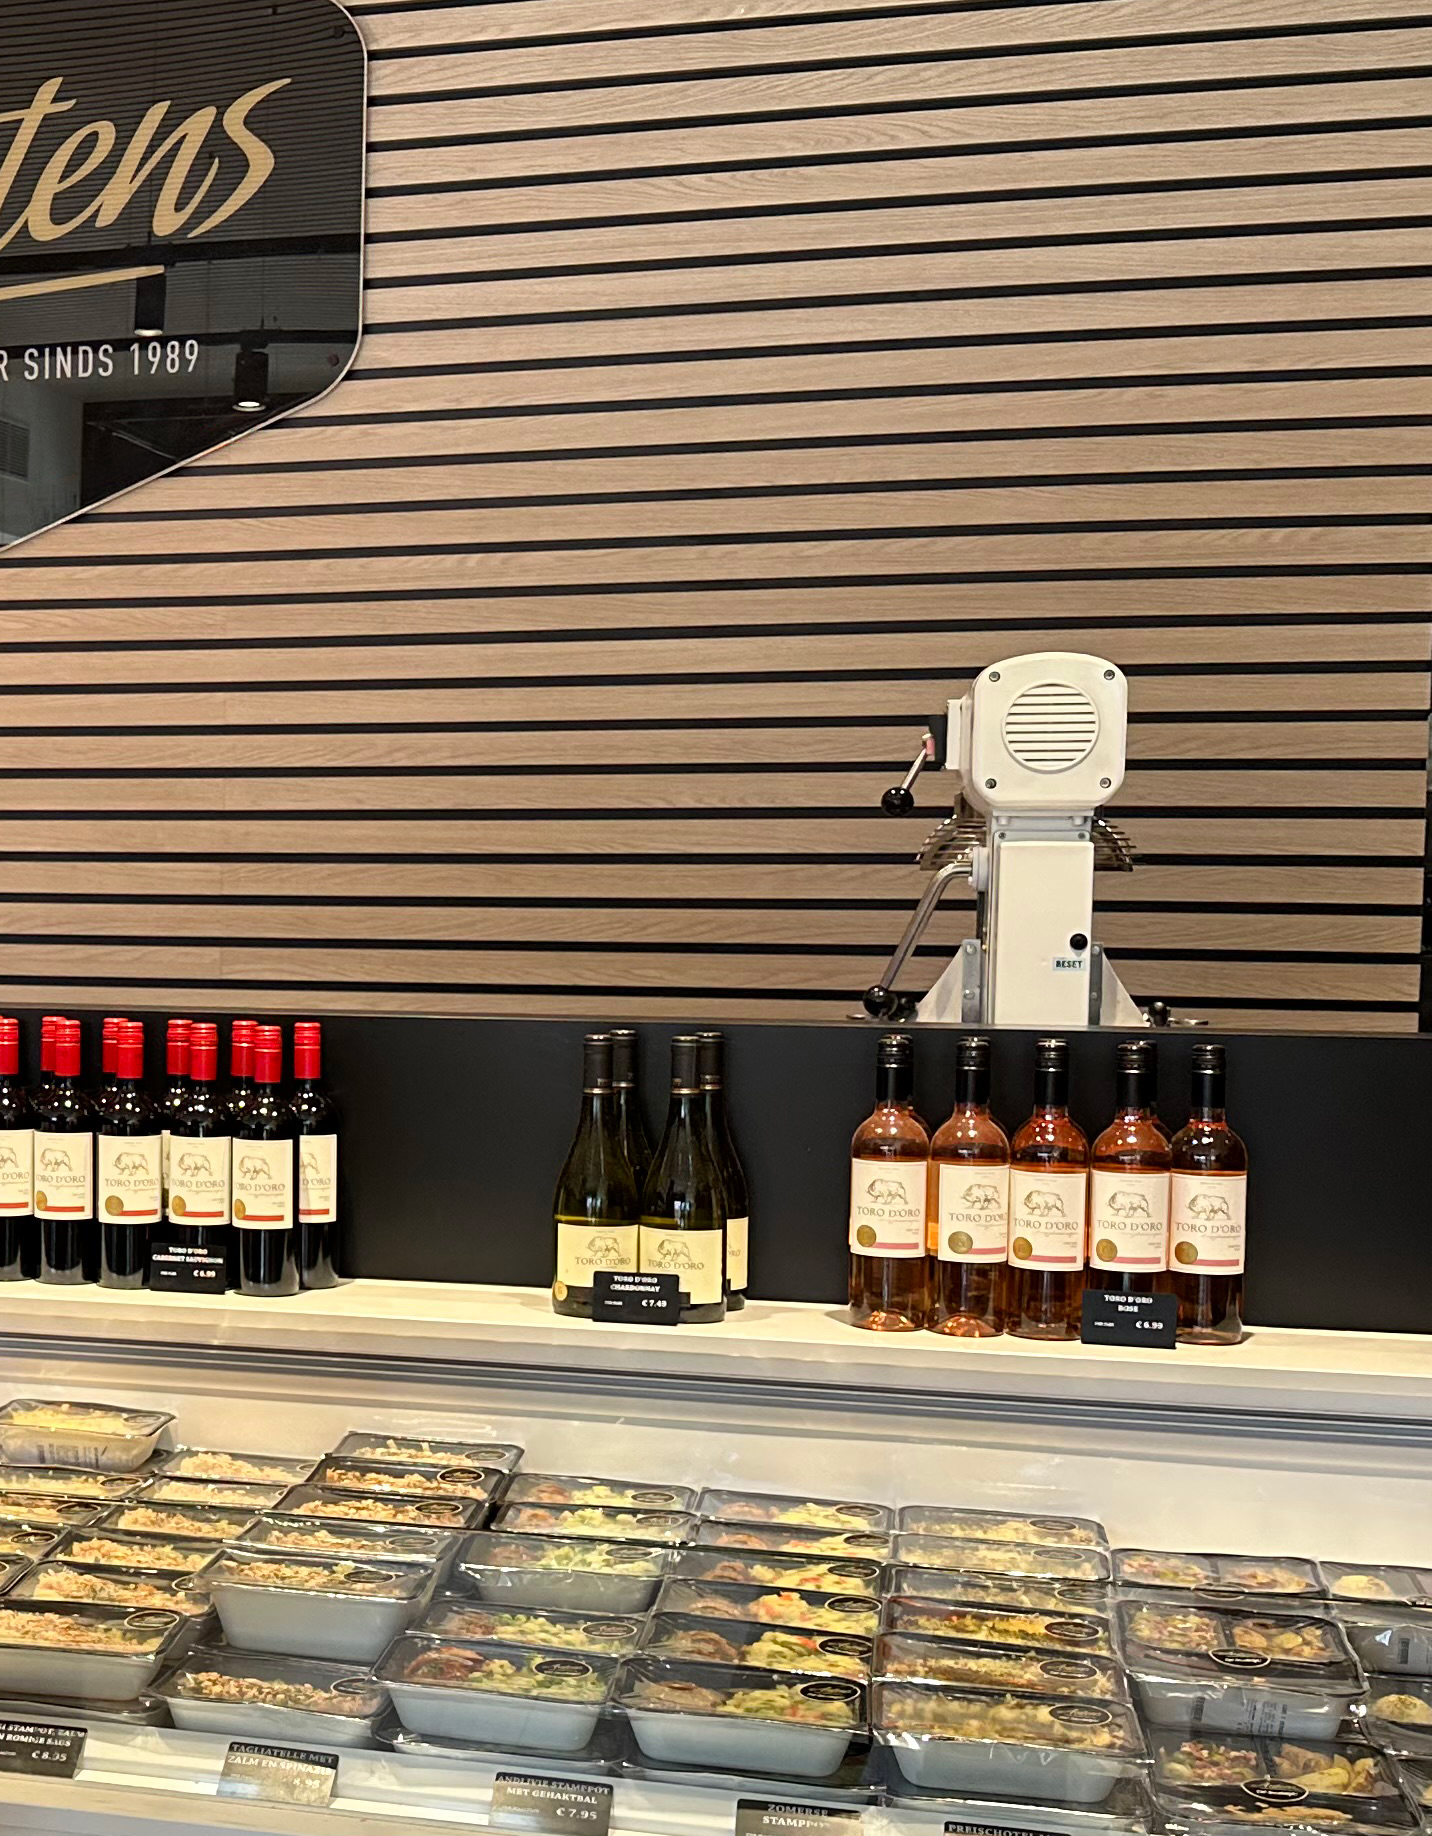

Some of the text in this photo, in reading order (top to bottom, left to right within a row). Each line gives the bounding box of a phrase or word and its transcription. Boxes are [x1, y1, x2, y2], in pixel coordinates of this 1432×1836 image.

[24, 344, 114, 381] SINDS
[130, 339, 199, 376] 1989
[1056, 960, 1082, 968] RESET
[2, 1172, 30, 1180] D'ORO
[56, 1175, 86, 1184] D'ORO
[104, 1178, 130, 1188] TORO
[196, 1180, 226, 1188] D'ORO
[235, 1182, 286, 1192] ORO D'ORO
[857, 1206, 920, 1218] TORO D'ORO
[949, 1212, 982, 1223] TORO
[1014, 1218, 1078, 1231] TORO D'ORO
[1096, 1220, 1163, 1232] TORO D'ORO
[1176, 1222, 1242, 1234] TORO D'ORO
[574, 1256, 602, 1266] TORO
[648, 1258, 704, 1270] TORO D'ORO
[31, 1750, 40, 1759] €
[232, 1744, 334, 1764] TAGLIATELLE MET
[228, 1756, 259, 1766] ZALM
[261, 1760, 277, 1768] EN
[506, 1787, 598, 1804] MET GEHAKTBAL
[556, 1807, 597, 1820] € 7.95
[767, 1804, 828, 1816] ZOMERSE
